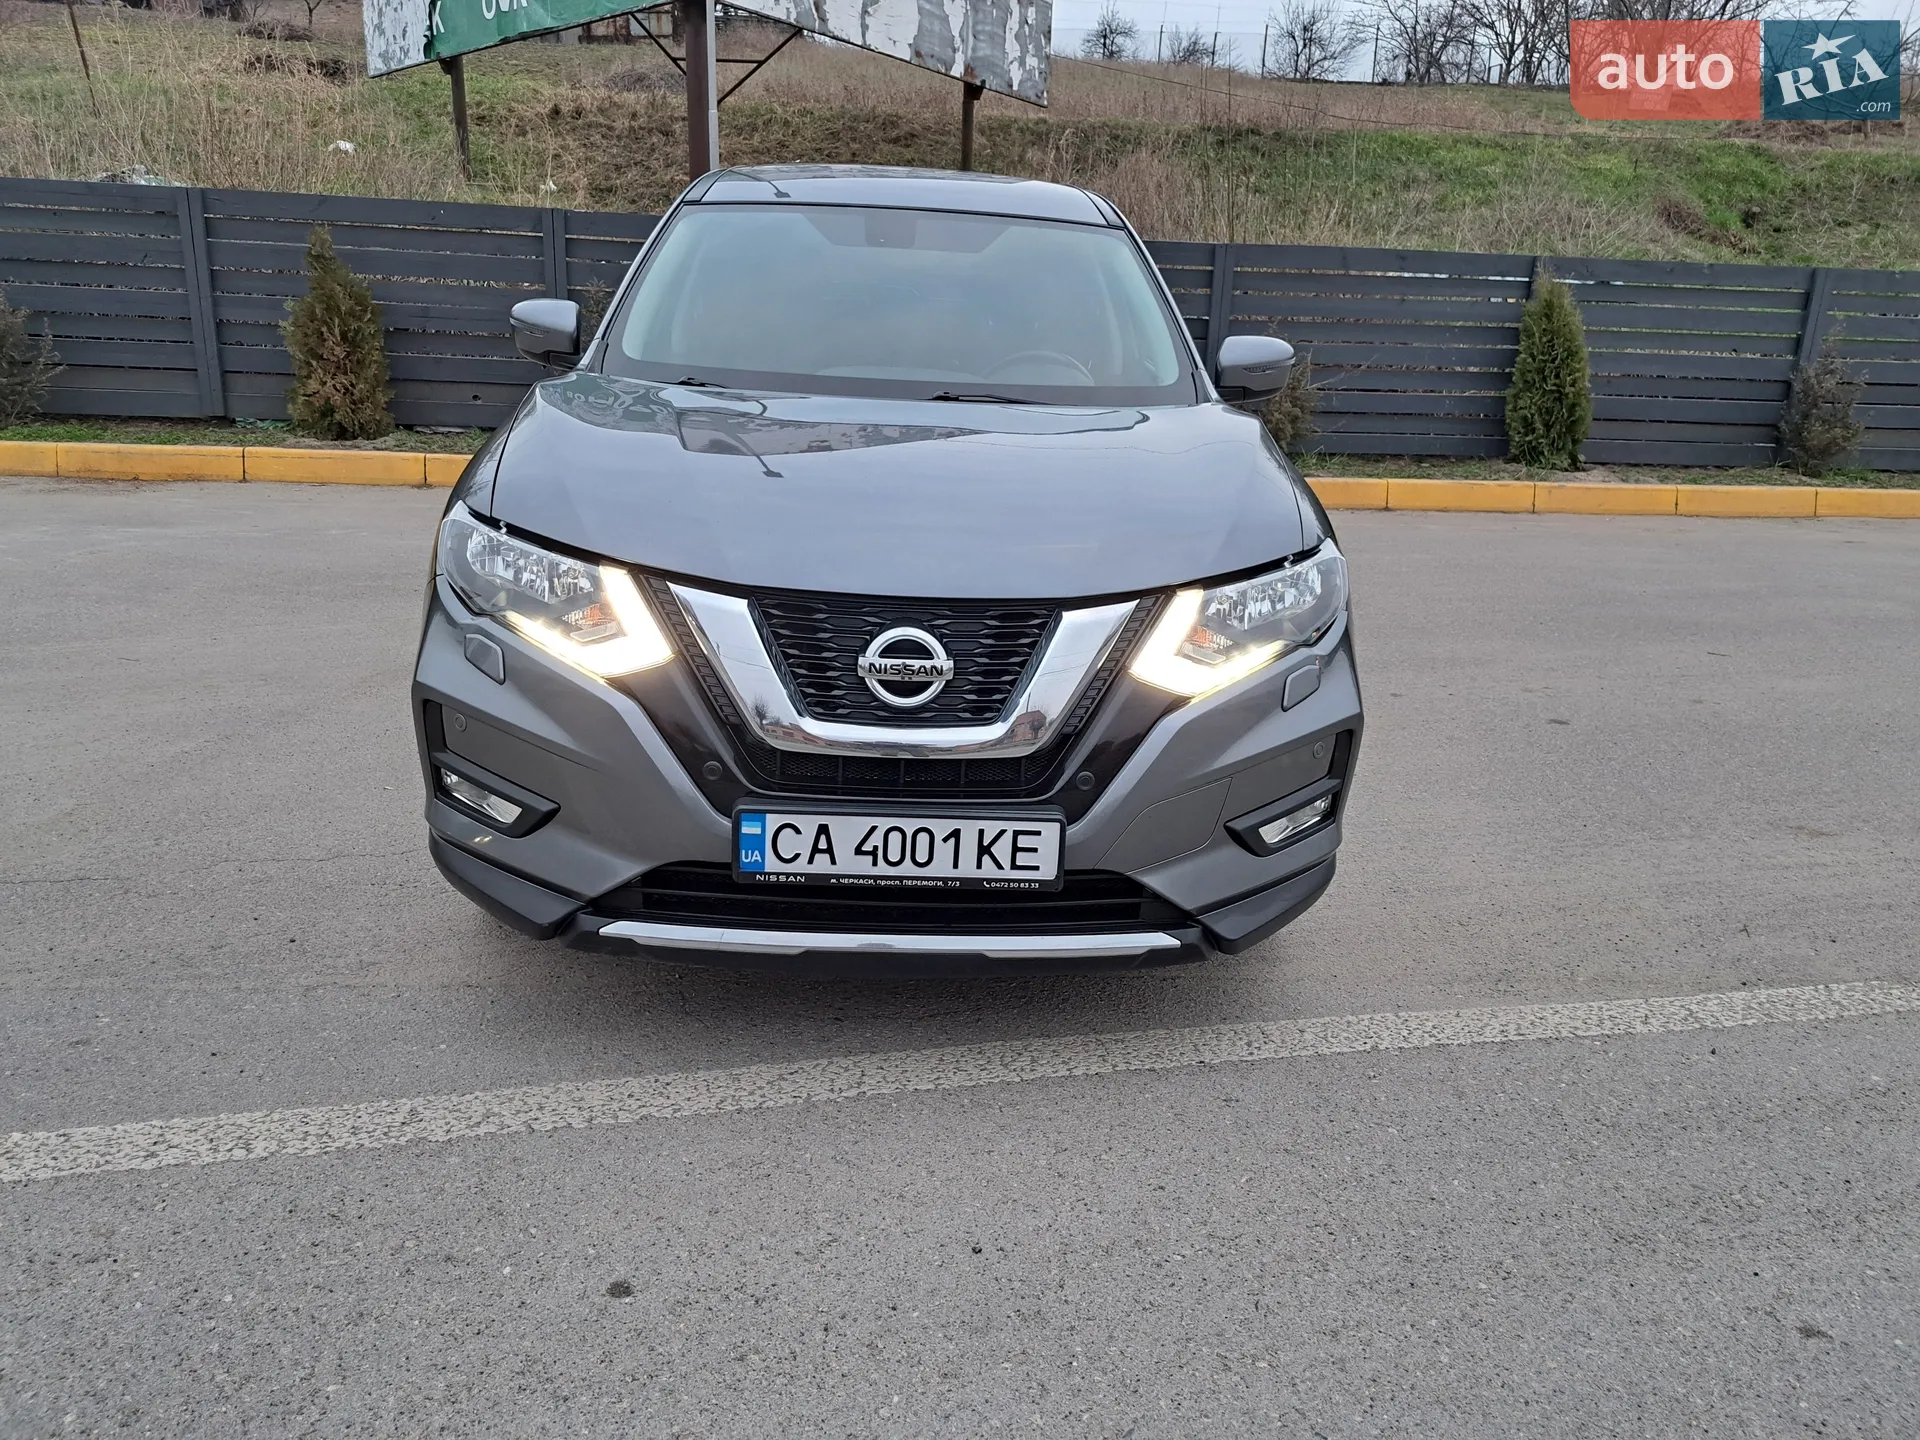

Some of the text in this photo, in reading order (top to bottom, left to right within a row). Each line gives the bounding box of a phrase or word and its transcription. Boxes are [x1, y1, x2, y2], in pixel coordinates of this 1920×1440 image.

[868, 662, 944, 676] NISSAN
[771, 822, 1042, 871] CA 4001 KE
[741, 849, 762, 863] UA
[755, 874, 805, 882] NISSAN
